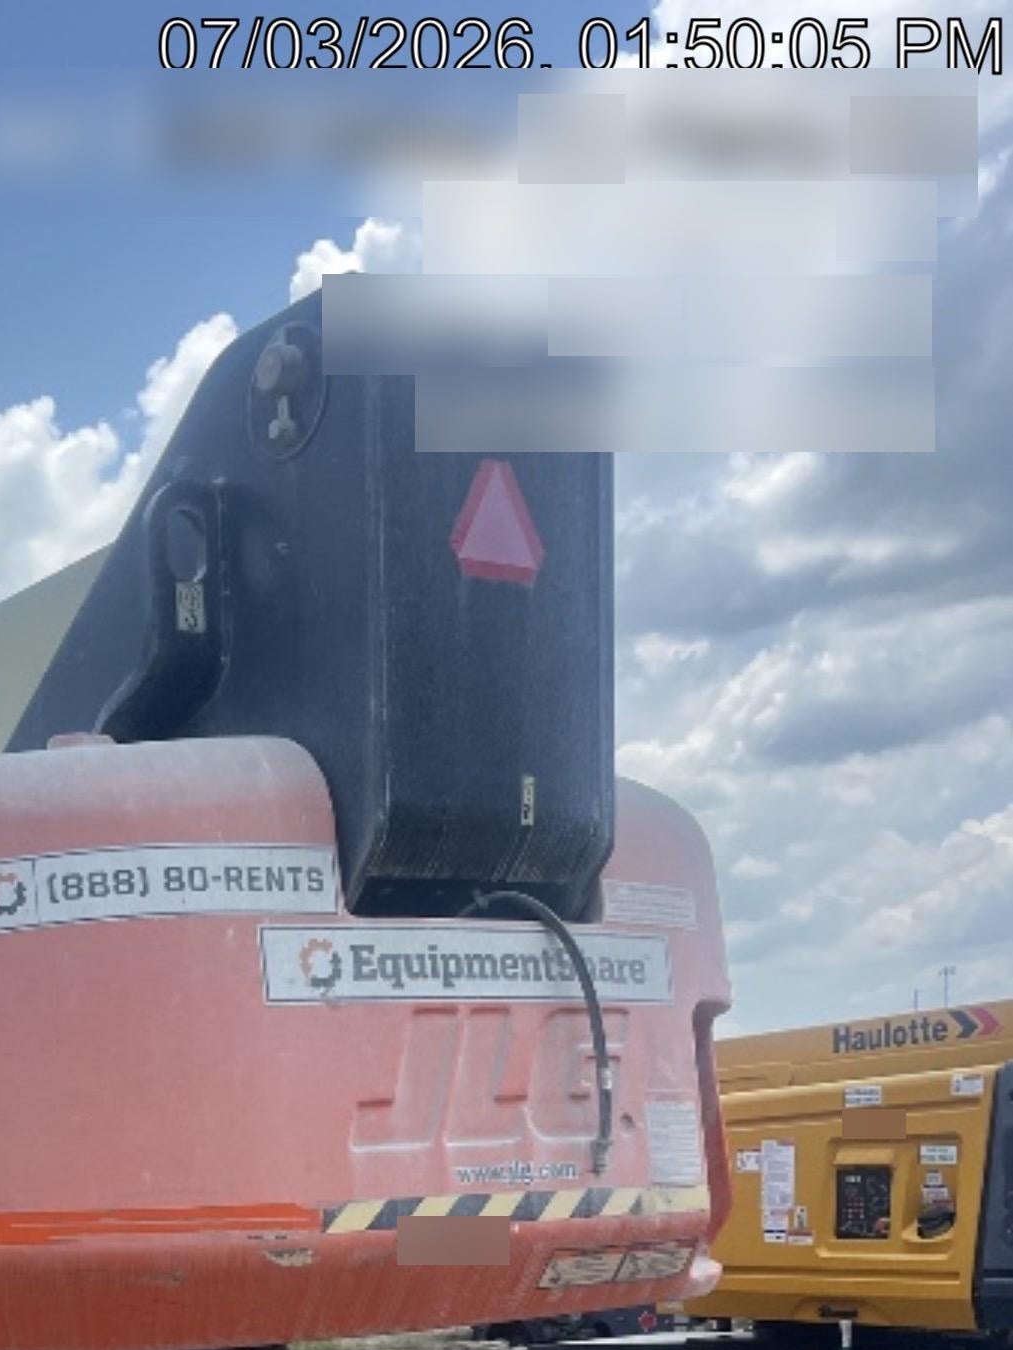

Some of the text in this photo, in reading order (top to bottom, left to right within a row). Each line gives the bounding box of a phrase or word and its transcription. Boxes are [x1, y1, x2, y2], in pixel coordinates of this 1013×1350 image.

[49, 866, 324, 904] (888) 80-RENTS
[832, 1019, 949, 1053] Haulotte
